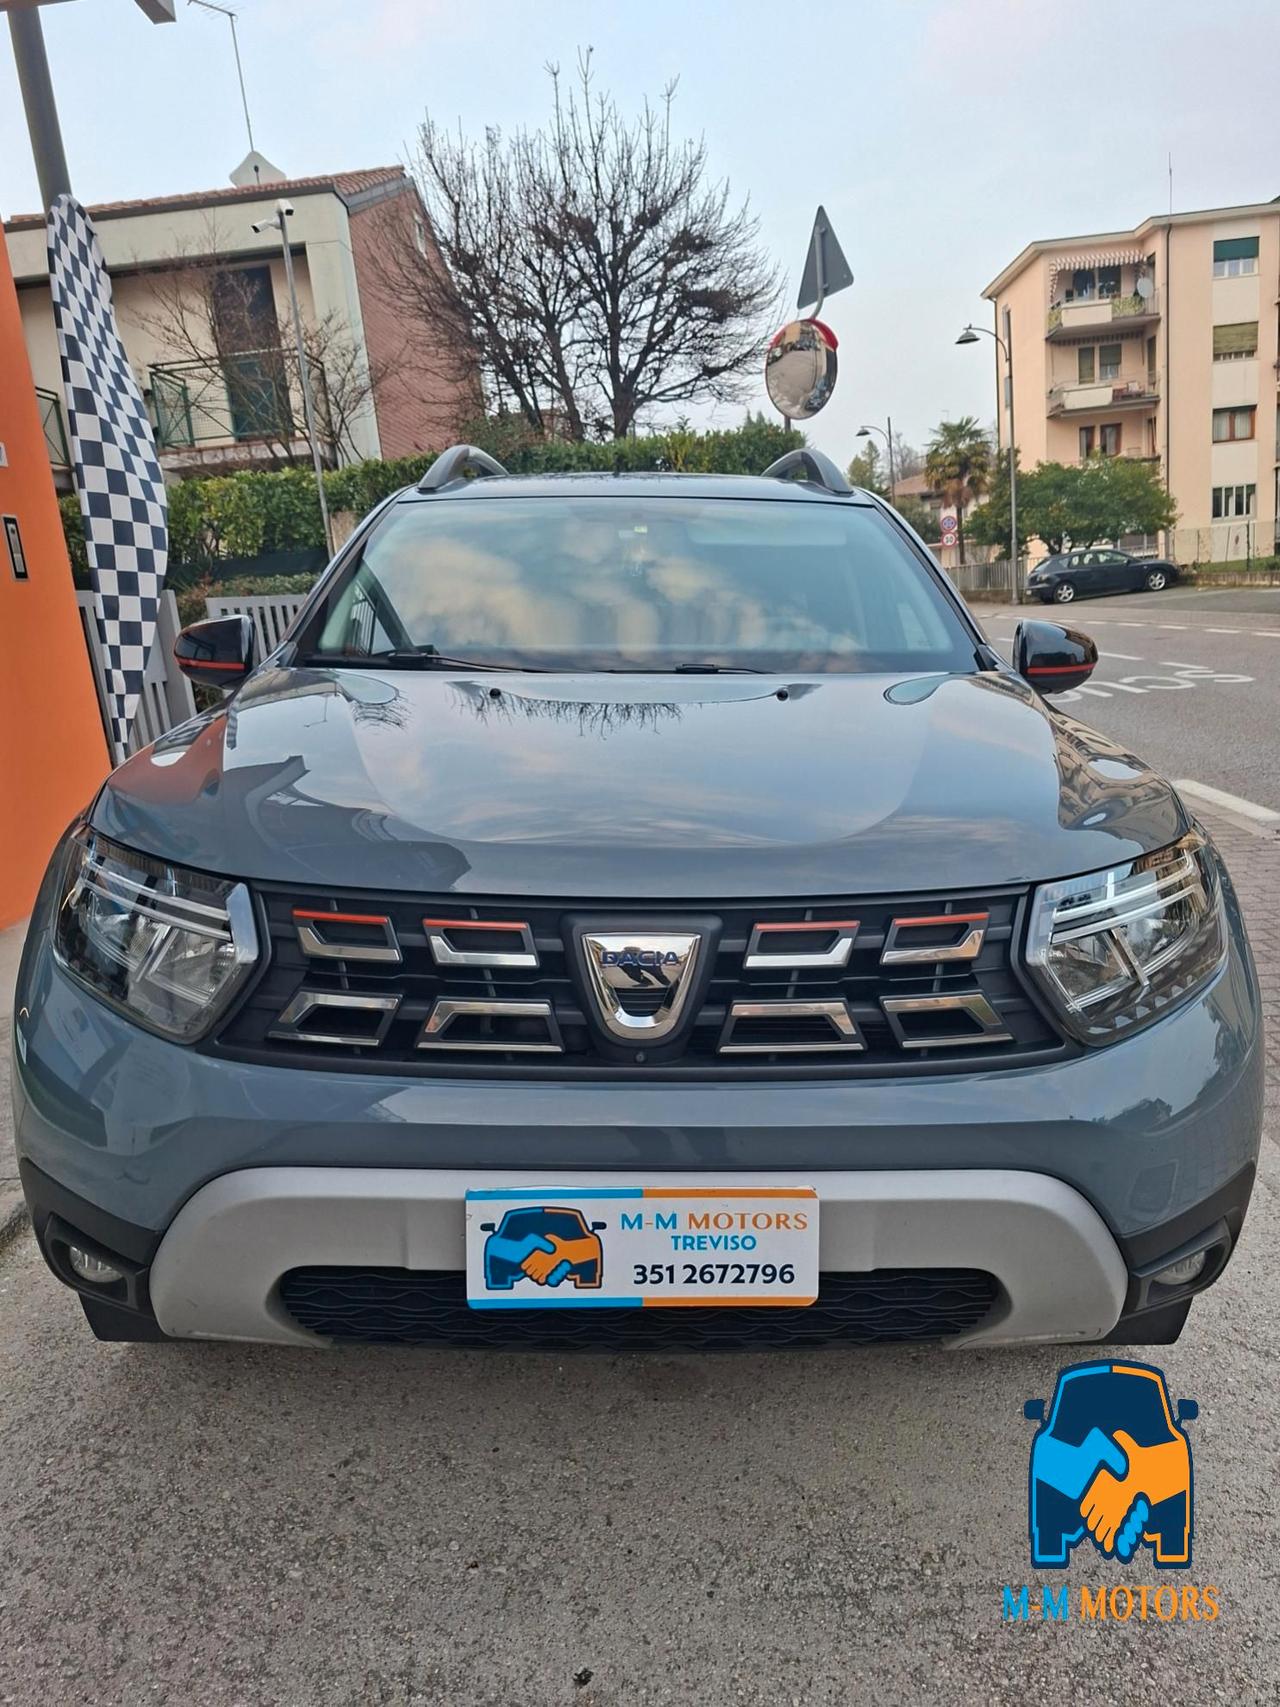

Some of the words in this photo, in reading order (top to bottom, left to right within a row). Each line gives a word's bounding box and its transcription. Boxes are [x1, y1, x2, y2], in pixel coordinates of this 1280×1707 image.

[601, 951, 680, 967] DACIA
[621, 1212, 677, 1230] M-M
[688, 1212, 808, 1230] MOTORS
[671, 1235, 757, 1251] TREVISO
[633, 1264, 675, 1285] 351
[682, 1263, 795, 1285] 2672796
